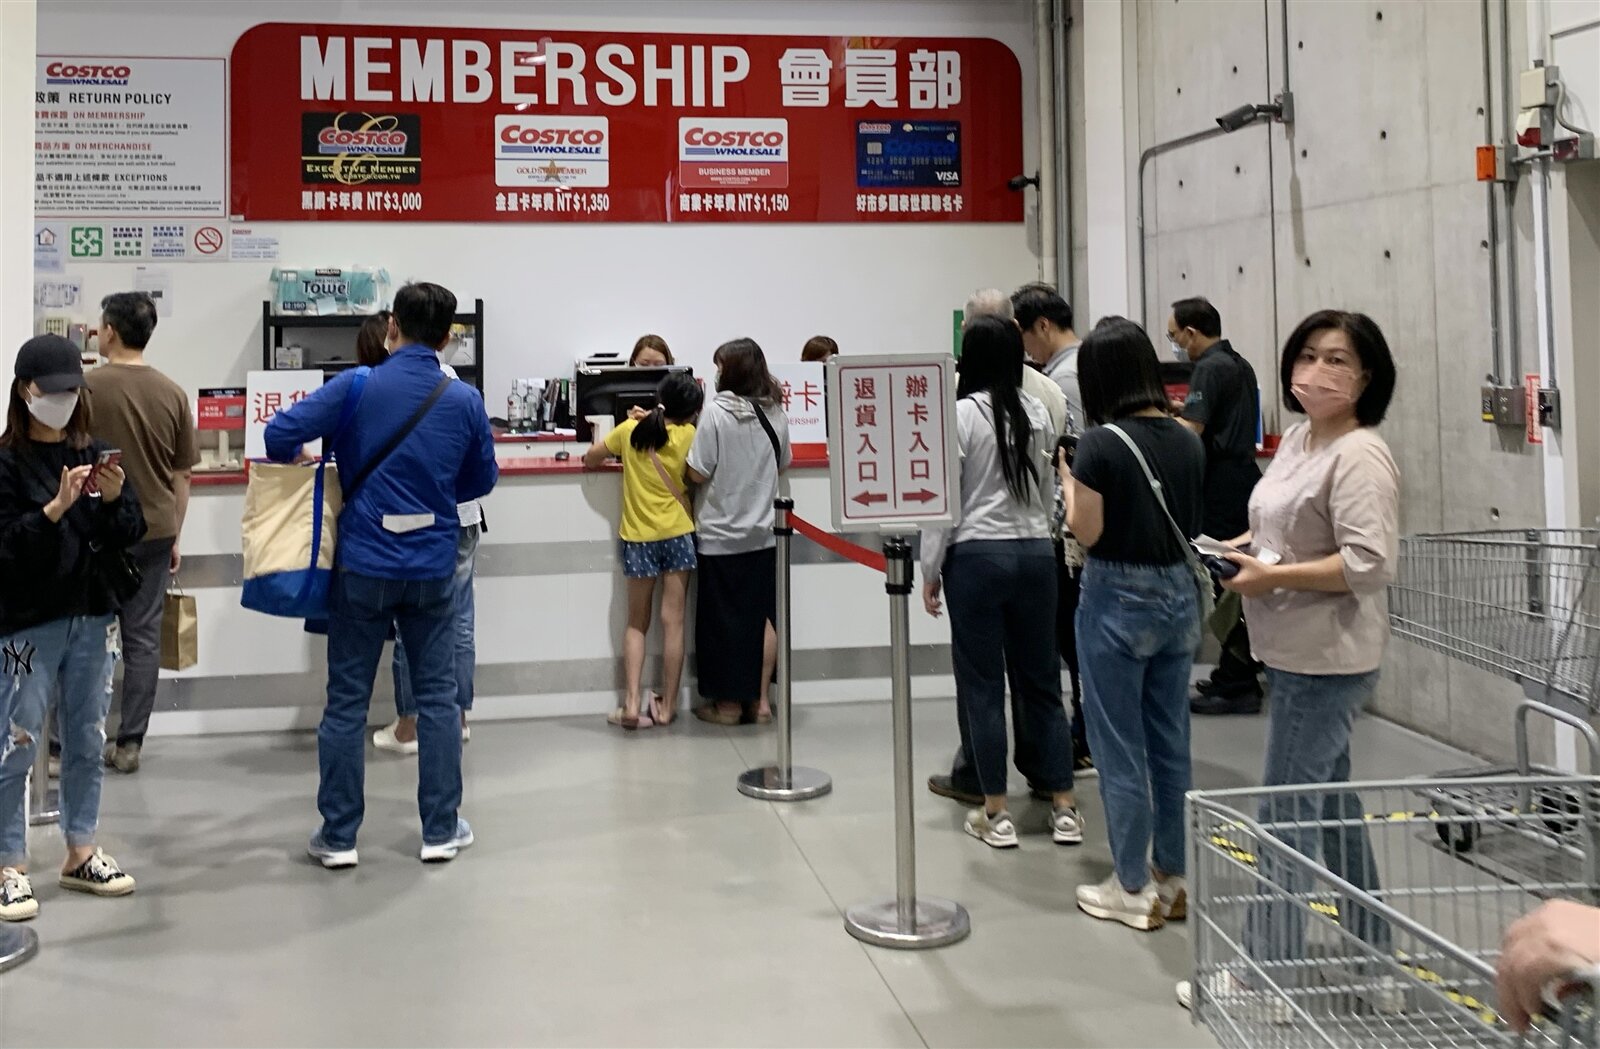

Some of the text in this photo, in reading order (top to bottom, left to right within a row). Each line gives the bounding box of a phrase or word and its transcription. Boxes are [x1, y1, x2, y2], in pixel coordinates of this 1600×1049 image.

[46, 62, 131, 78] COSTCO
[300, 35, 962, 110] MEMBERSHIP 會員部
[69, 93, 120, 104] RETURN
[125, 93, 172, 104] POLICY
[87, 112, 146, 120] MEMBERSHIP
[319, 127, 407, 146] COSTCO
[500, 125, 605, 145] COSTCO
[684, 127, 784, 147] COSTCO
[75, 142, 87, 150] ON
[89, 142, 152, 151] MERCHANDISE
[532, 146, 602, 154] WHOLESALE
[715, 148, 781, 156] WHOLESALE
[114, 173, 168, 182] EXCEPTIONS
[370, 165, 417, 174] MEMBER
[698, 167, 771, 176] BUSINESS MEMBER
[935, 171, 959, 181] VISA
[366, 191, 422, 213] NT$3,000
[556, 192, 610, 215] NT$1,350
[738, 193, 789, 215] NT$1,150
[301, 280, 351, 296] Towel
[853, 376, 878, 483] 退貨入口
[905, 374, 931, 481] 辦卡入口
